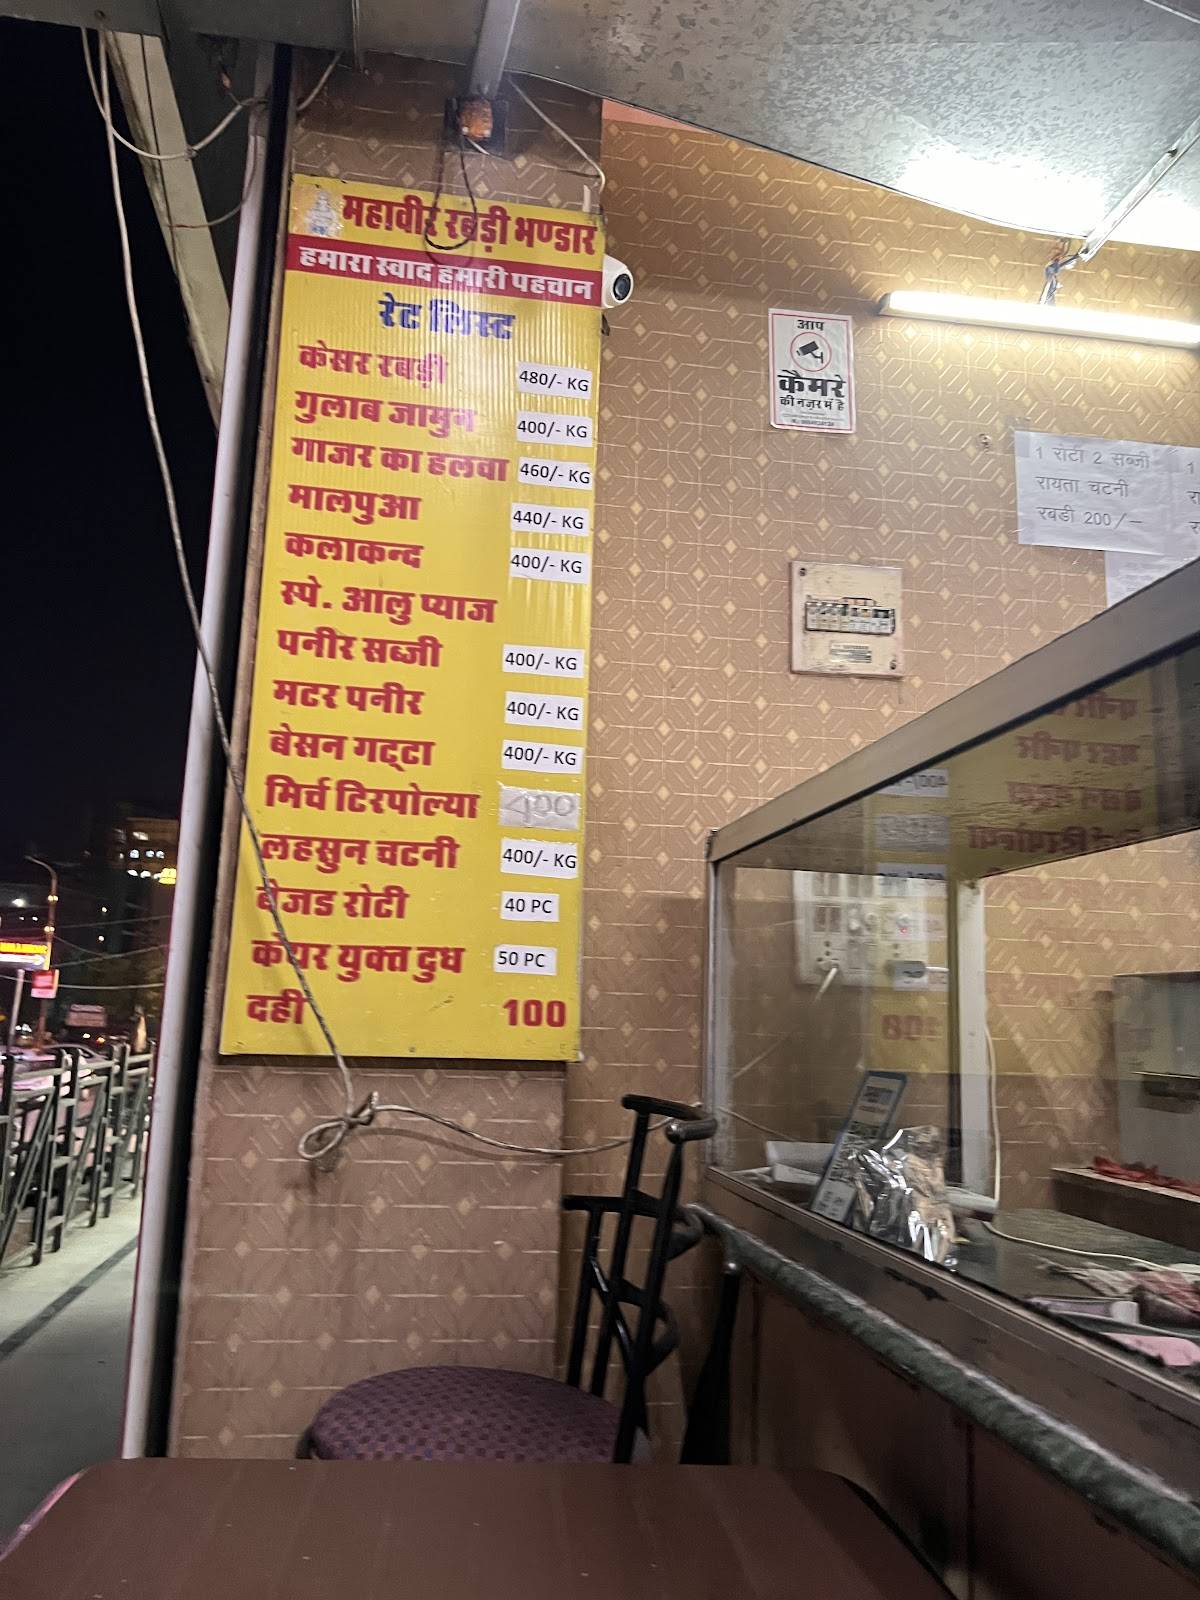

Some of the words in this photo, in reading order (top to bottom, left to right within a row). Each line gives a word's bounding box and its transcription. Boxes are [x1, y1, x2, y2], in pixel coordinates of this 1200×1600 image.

[342, 194, 440, 237] महावीर
[445, 205, 512, 253] रबड़ी
[515, 217, 598, 255] भण्डार
[299, 246, 374, 275] हमारा
[376, 256, 437, 282] स्वाद
[438, 265, 508, 290] हमारी
[511, 273, 594, 299] पहचान
[378, 292, 422, 329] रेट
[430, 298, 516, 340] लिस्ट
[797, 320, 824, 331] आप
[298, 340, 373, 375] केसर
[378, 352, 448, 388] रबड़ी
[519, 369, 562, 389] 480/-
[567, 377, 589, 391] KG
[777, 369, 846, 397] कैमरे
[295, 391, 384, 424] गुलाब
[388, 402, 478, 438] जामुन
[518, 419, 561, 438] 400/-
[566, 425, 587, 438] KG
[291, 437, 375, 468] गाजर
[380, 446, 423, 473] का
[427, 451, 510, 481] हलवा
[520, 463, 564, 482] 460/-
[569, 470, 590, 484] KG
[1093, 452, 1102, 464] 2
[1110, 451, 1151, 469] सब्जी
[1035, 476, 1080, 493] रायता
[1087, 479, 1129, 497] चटनी
[288, 484, 422, 525] मालपुआ
[513, 510, 557, 529] 440/-
[562, 515, 584, 530] KG
[285, 532, 424, 568] कलाकन्द
[510, 553, 555, 573] 400/-
[560, 560, 582, 574] KG
[342, 586, 416, 625] आलु
[420, 594, 497, 623] प्याज
[277, 626, 357, 660] पनीर
[362, 635, 443, 667] सब्जी
[505, 651, 550, 670] 400/-
[555, 656, 577, 671] KG
[273, 680, 340, 709] मटर
[346, 682, 424, 715] पनीर
[507, 701, 551, 720] 400/-
[557, 706, 579, 721] KG
[269, 722, 348, 760] बेसन
[504, 746, 549, 765] 400/-
[554, 750, 577, 766] KG
[265, 774, 332, 809] मिर्च
[335, 779, 481, 819] टिरपोल्या
[503, 794, 576, 823] 400
[259, 833, 370, 874] लहसुन
[376, 836, 460, 869] चटनी
[502, 848, 549, 868] 400/-
[554, 853, 577, 869] KG
[342, 883, 411, 919] रोटी
[505, 898, 526, 913] 40
[531, 900, 552, 914] PC
[337, 945, 411, 982] युक्त
[497, 951, 518, 967] 50
[524, 954, 547, 968] PC
[246, 988, 309, 1024] दही
[502, 999, 566, 1027] 100
